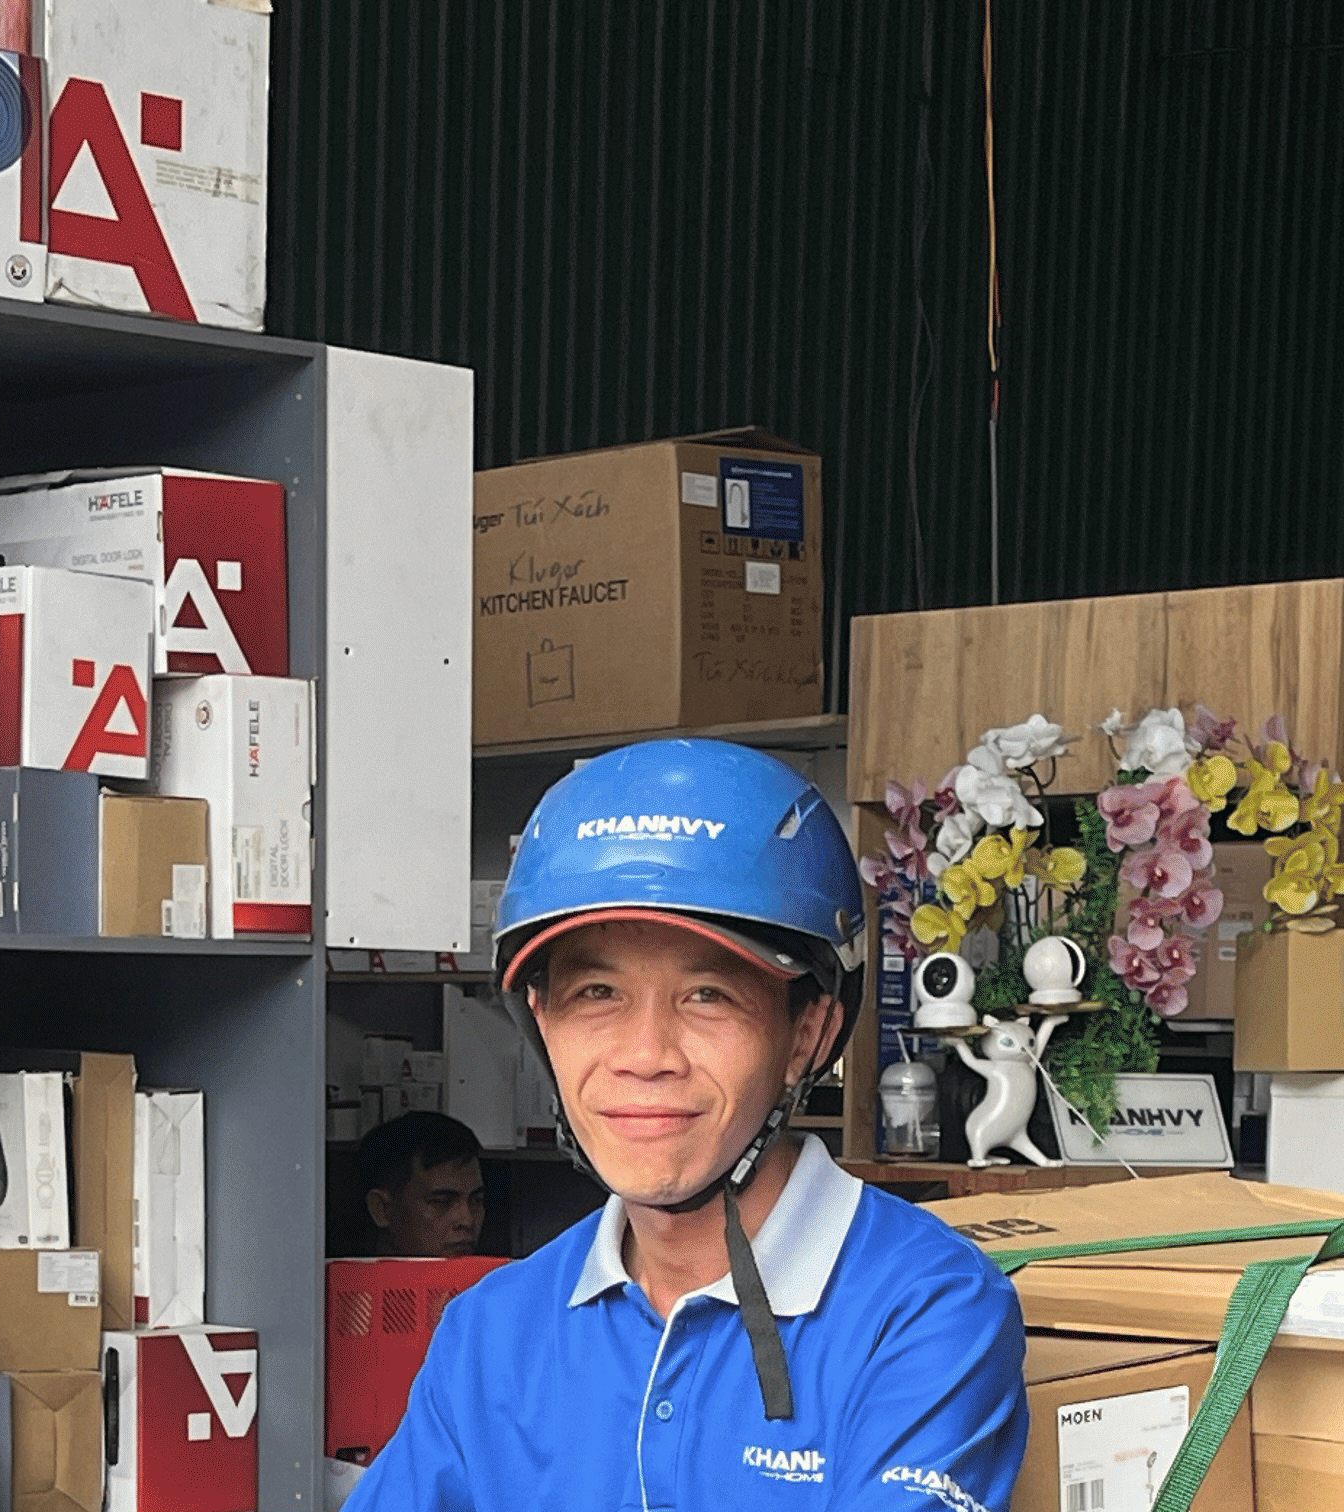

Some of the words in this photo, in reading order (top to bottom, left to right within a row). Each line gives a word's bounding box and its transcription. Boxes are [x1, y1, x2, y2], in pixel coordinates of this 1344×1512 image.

[508, 497, 545, 529] Túi
[550, 490, 611, 525] Xách
[509, 550, 586, 591] Kluger
[480, 589, 555, 617] KITCHEN
[558, 578, 630, 608] FAUCET
[577, 814, 727, 842] KHANHVY
[1067, 1107, 1205, 1127] KANHVY
[1061, 1408, 1103, 1427] MOEN
